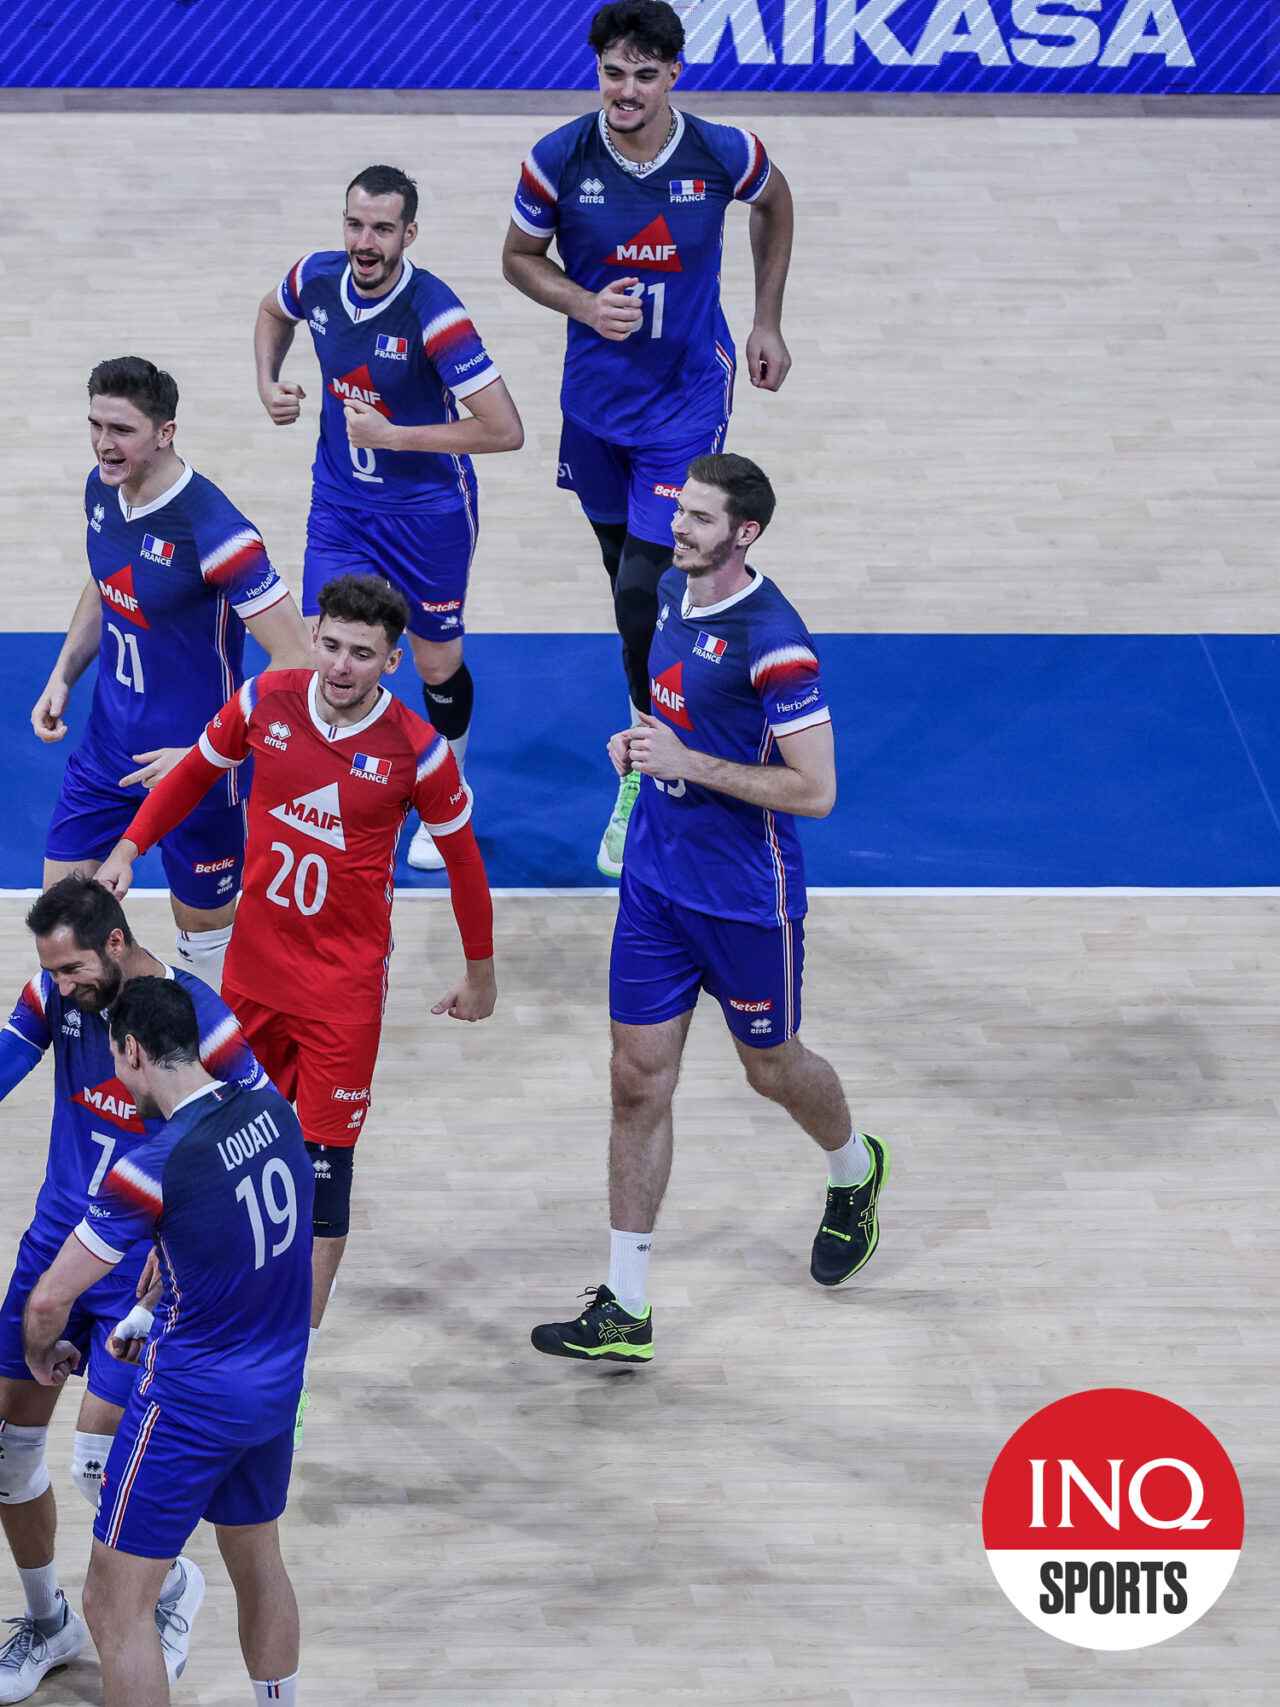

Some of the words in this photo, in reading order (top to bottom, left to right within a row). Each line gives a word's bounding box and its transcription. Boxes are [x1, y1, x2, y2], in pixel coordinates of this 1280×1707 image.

[579, 194, 605, 204] errea
[670, 194, 706, 203] FRANCE
[616, 245, 677, 261] MAIF
[375, 350, 408, 361] FRANCE
[333, 378, 381, 405] MAIF
[655, 485, 682, 498] Betc
[140, 551, 172, 567] FRANCE
[98, 579, 138, 612] MAIF
[422, 600, 460, 612] Betclic
[107, 622, 144, 694] 21
[692, 647, 722, 664] FRANCE
[651, 678, 685, 712] MAIF
[776, 694, 819, 713] Herbalife
[264, 734, 288, 751] errea
[350, 768, 388, 785] FRANCE
[284, 802, 342, 831] MAIF
[194, 858, 235, 873] Betclic
[266, 841, 328, 916] 20
[730, 999, 771, 1012] Betclic
[83, 1087, 137, 1121] MAIF
[216, 1110, 280, 1172] LOUATI
[90, 1131, 116, 1197] 7
[235, 1157, 298, 1271] 19
